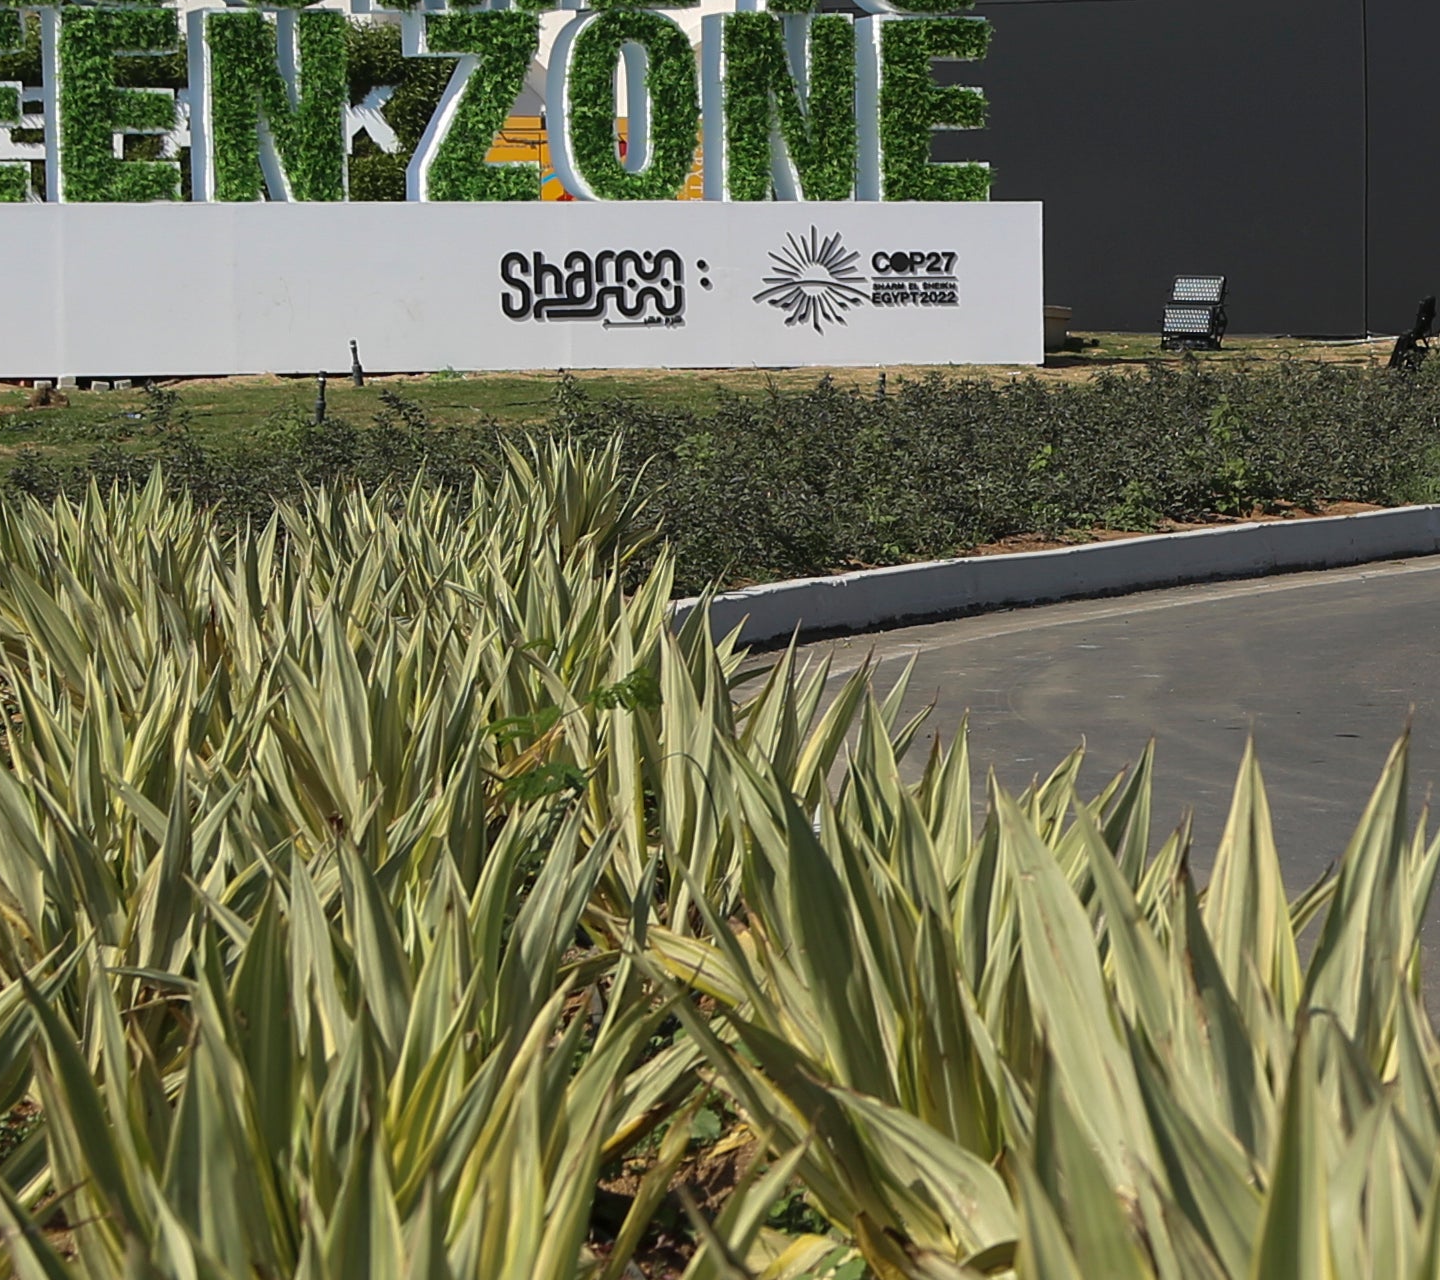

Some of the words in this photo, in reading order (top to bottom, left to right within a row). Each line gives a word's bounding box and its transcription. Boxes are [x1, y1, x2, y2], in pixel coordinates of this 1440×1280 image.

[402, 8, 993, 202] ZONE
[871, 251, 957, 274] COP27
[873, 282, 905, 291] SHARM
